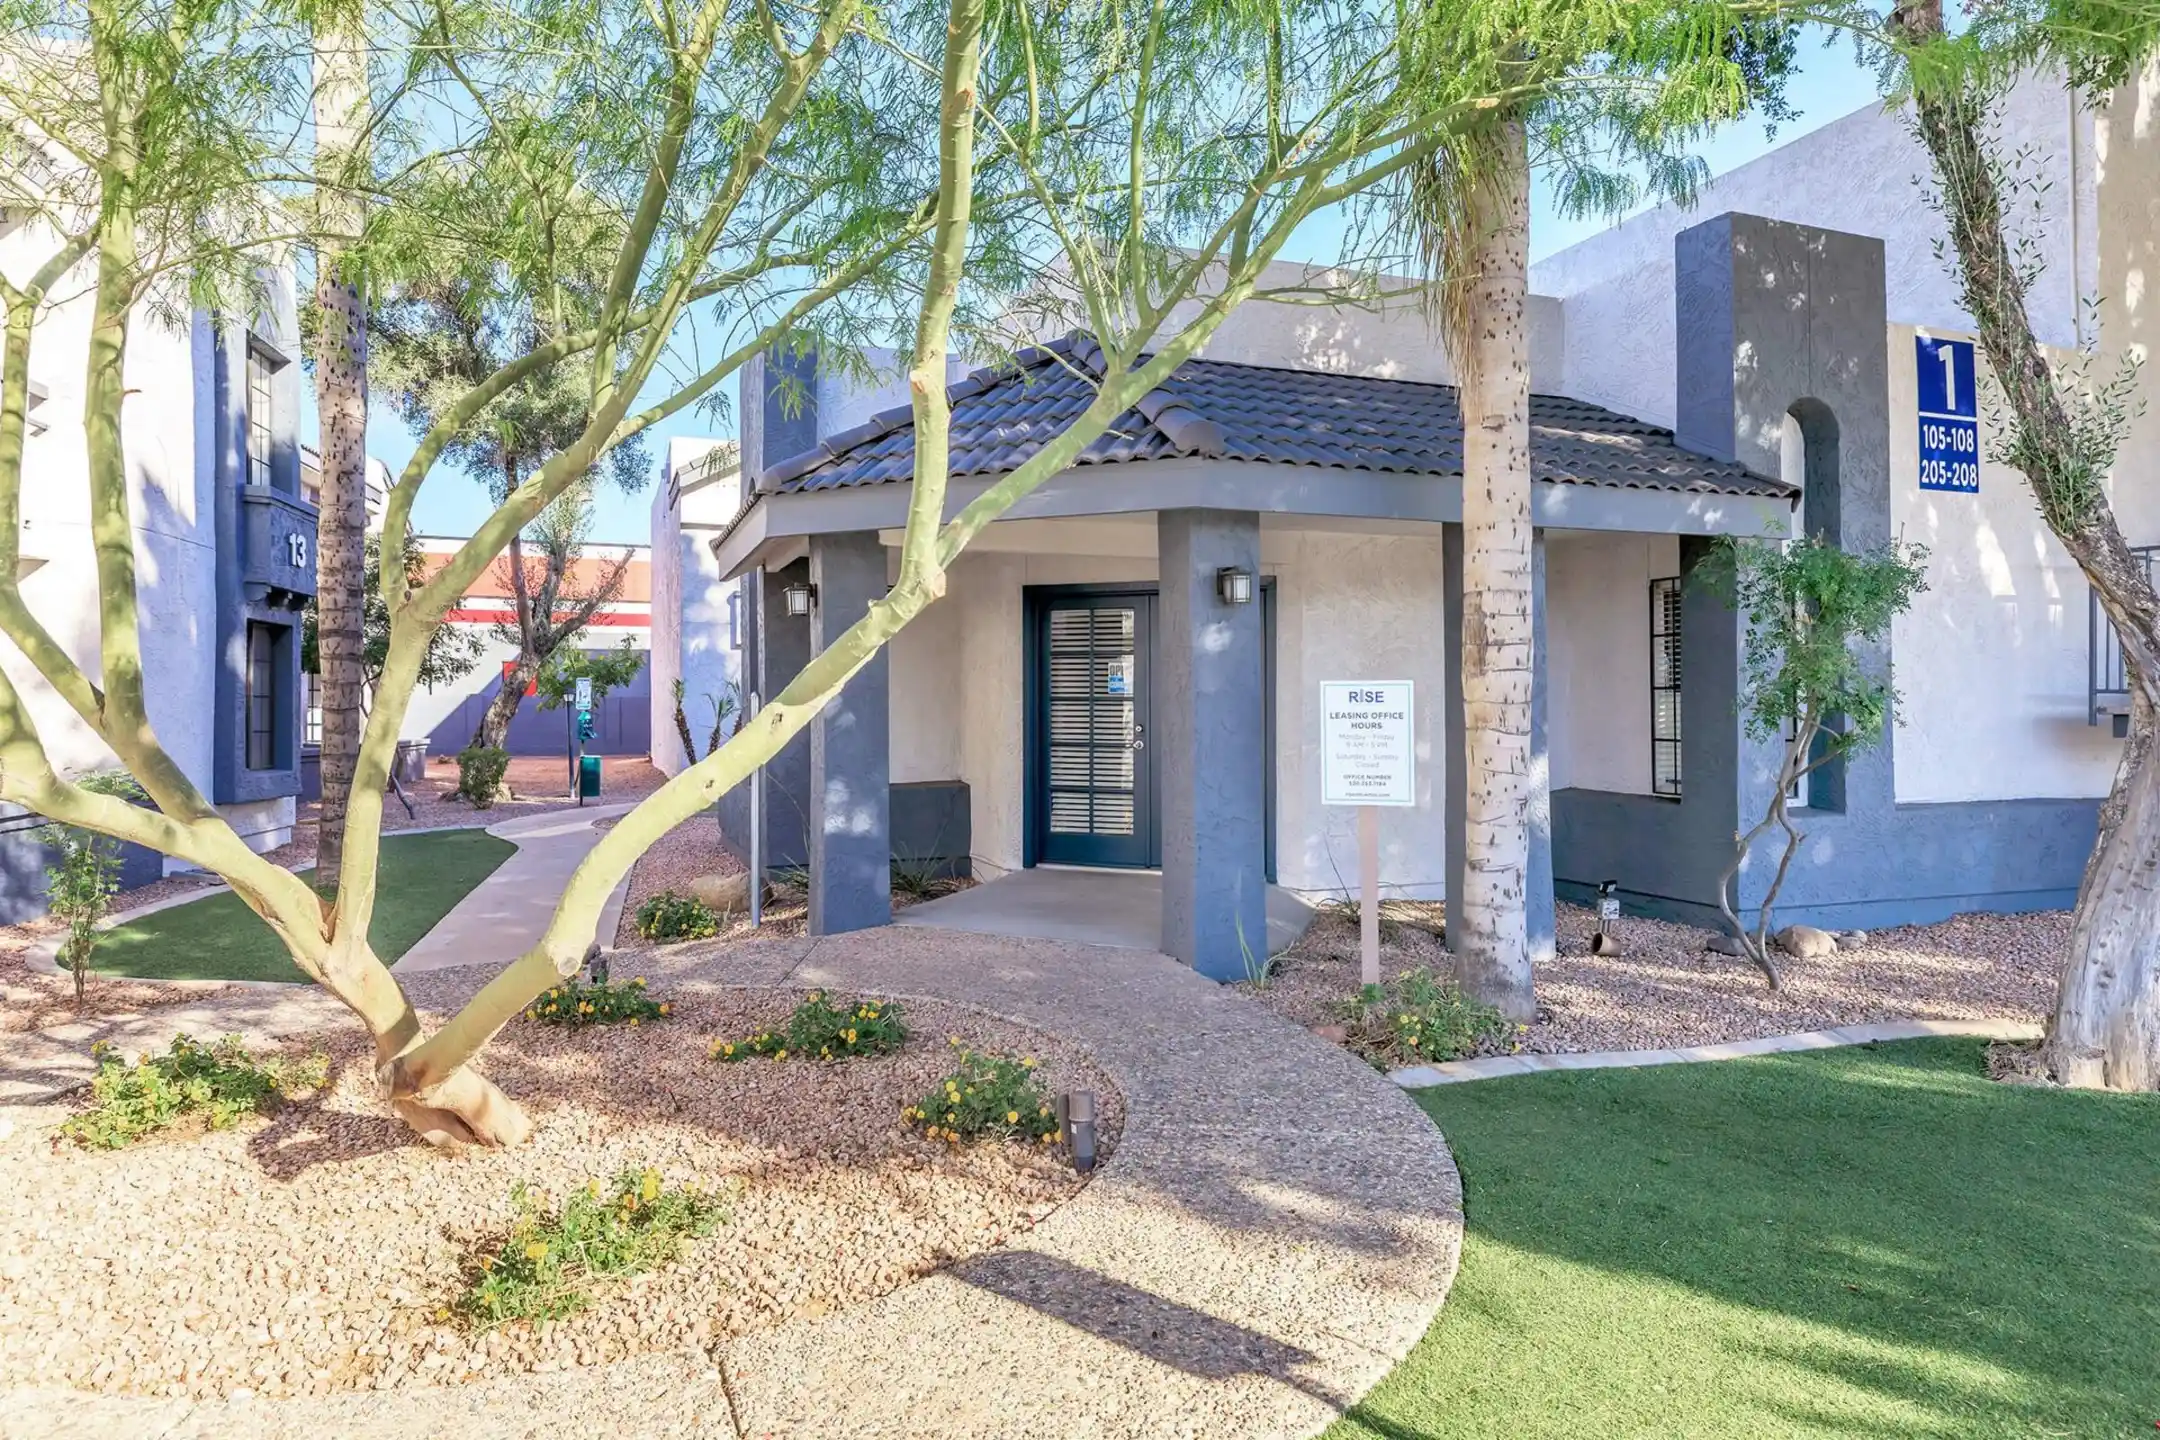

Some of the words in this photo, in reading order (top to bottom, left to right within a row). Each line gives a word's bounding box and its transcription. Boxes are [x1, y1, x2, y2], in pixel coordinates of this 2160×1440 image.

[1938, 344, 1956, 411] 1
[1922, 424, 1975, 453] 105-108
[1921, 459, 1978, 487] 205-208
[289, 533, 307, 568] 13
[1348, 688, 1385, 703] RISE
[1329, 711, 1369, 720] LEASING
[1371, 711, 1405, 720] OFFICE
[1350, 721, 1383, 730] HOURS
